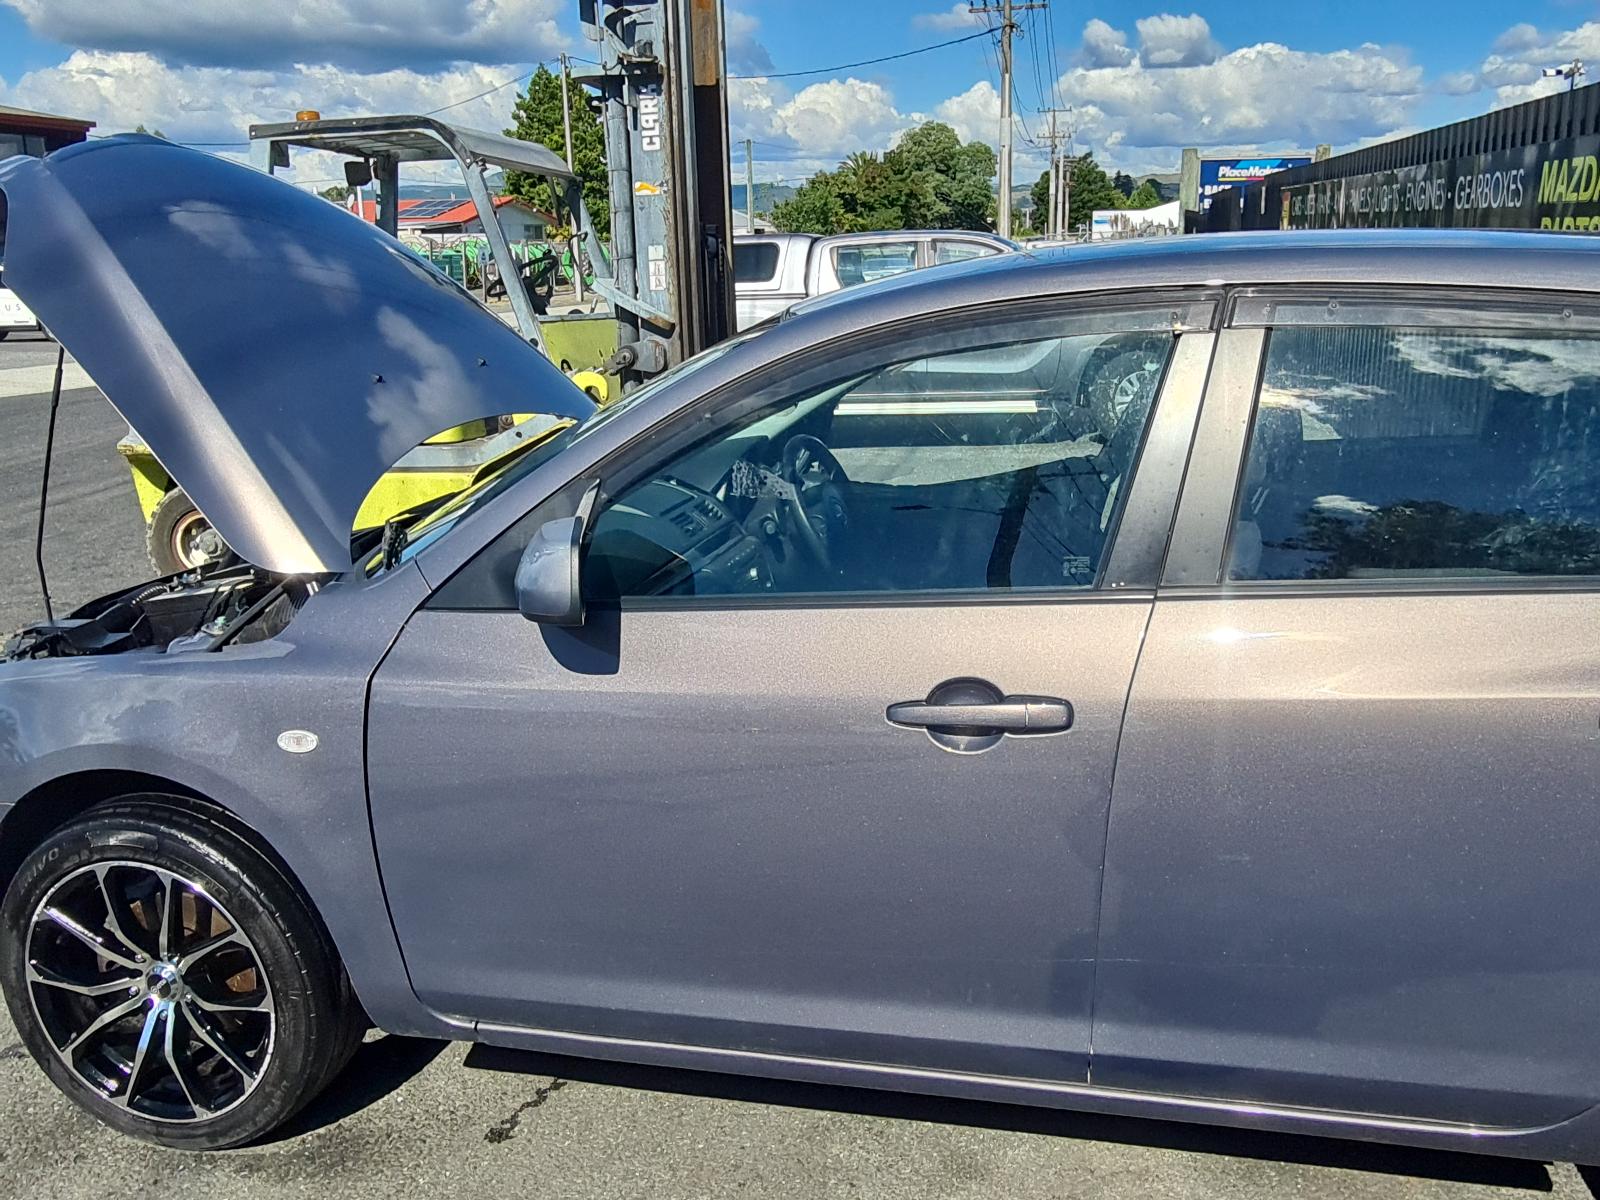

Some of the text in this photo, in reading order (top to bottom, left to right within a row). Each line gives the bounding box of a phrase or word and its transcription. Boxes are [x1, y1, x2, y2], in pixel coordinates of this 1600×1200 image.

[1218, 165, 1288, 177] PlaceMak
[1405, 178, 1445, 212] ENGINES
[1455, 168, 1524, 210] GEARBOXES
